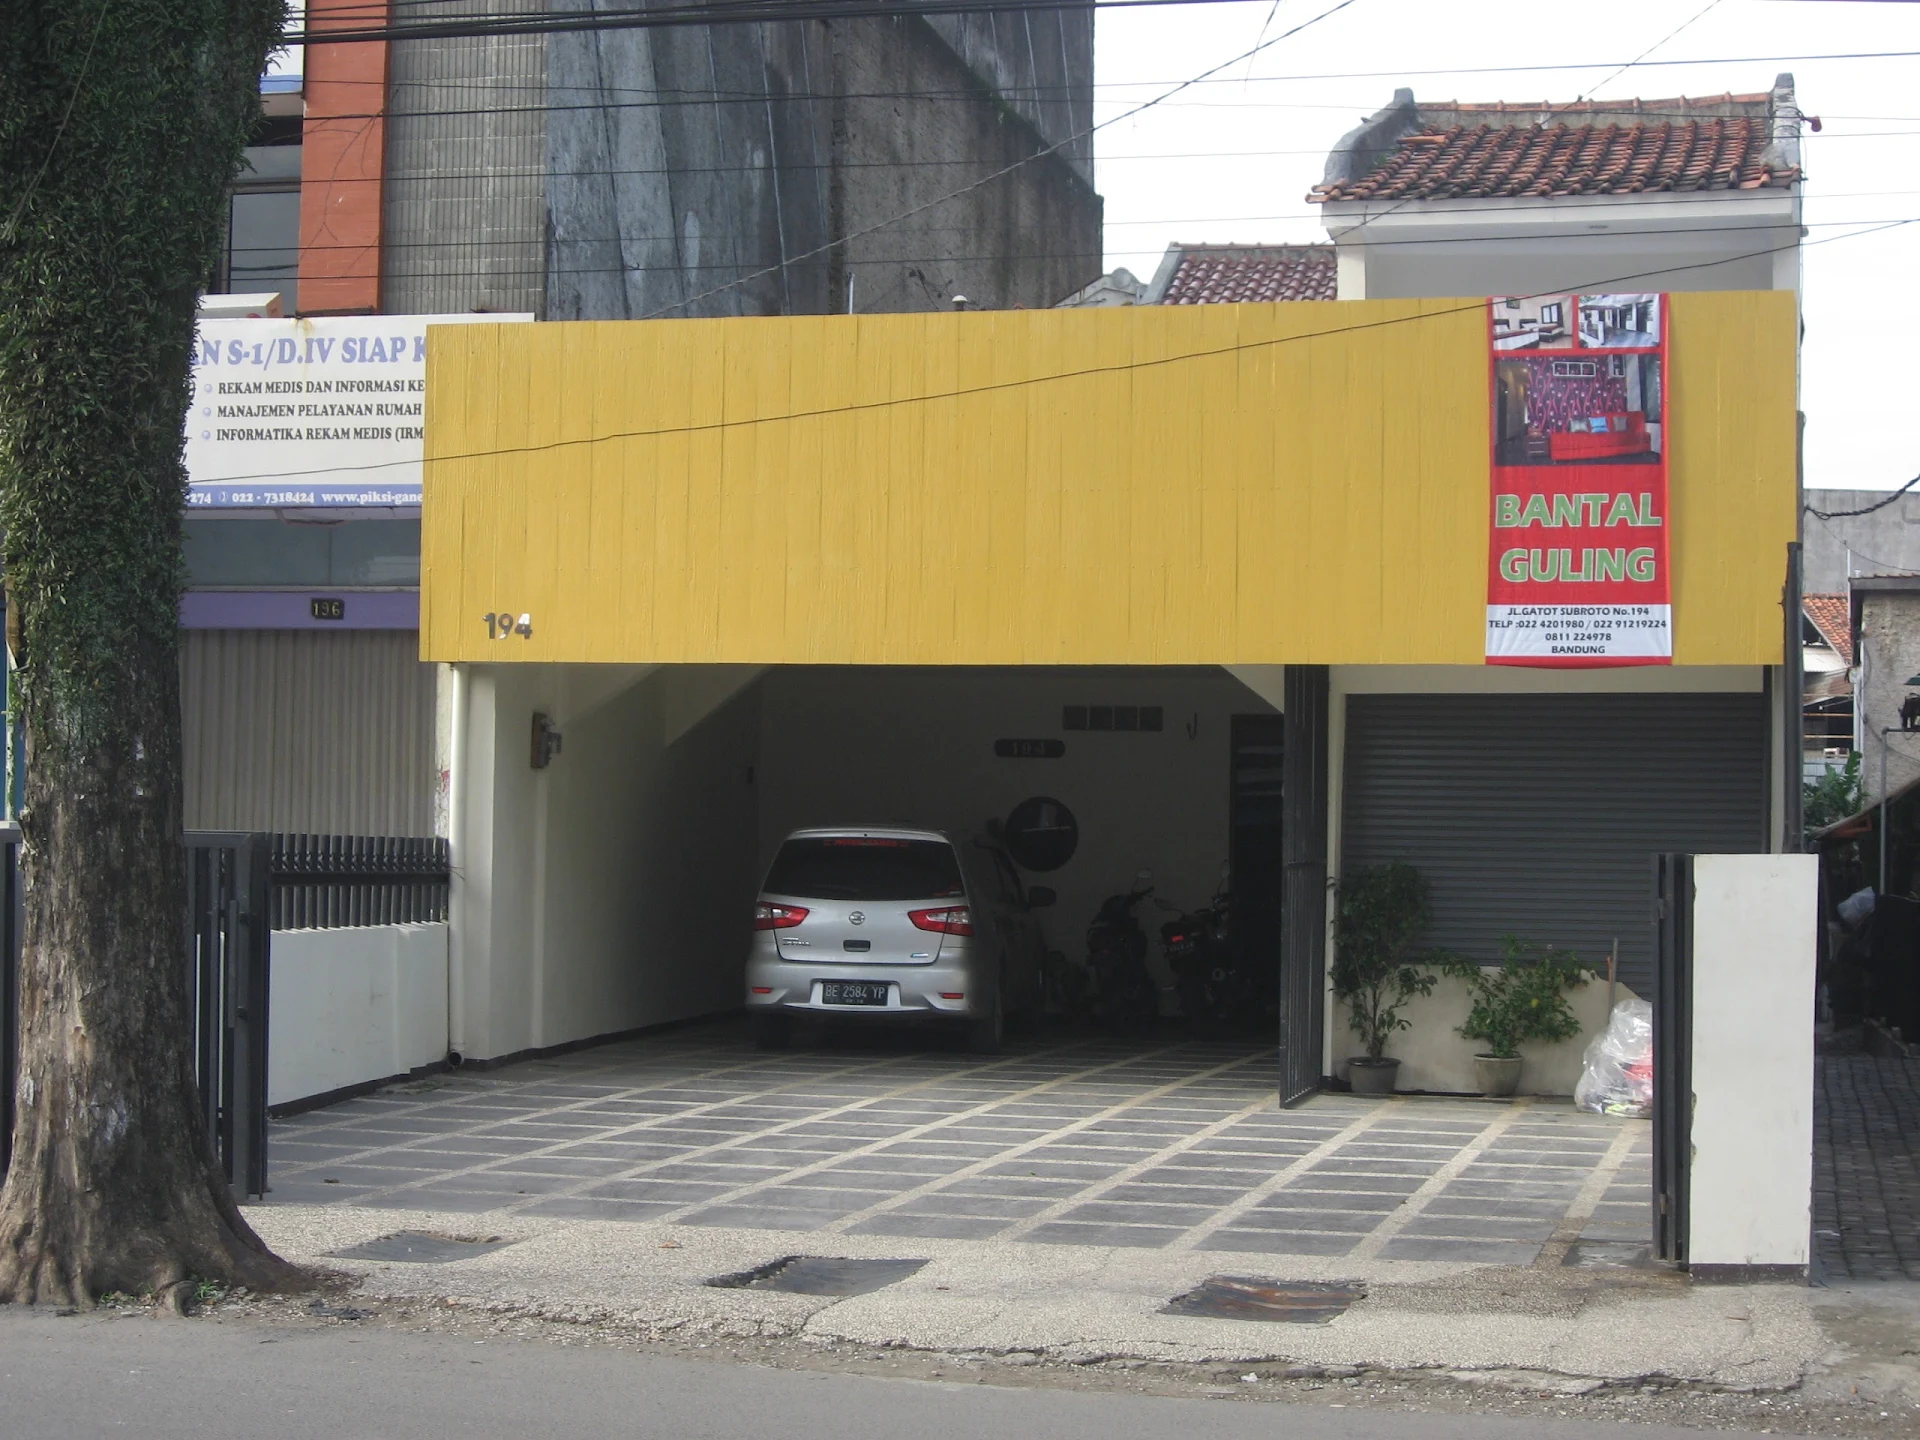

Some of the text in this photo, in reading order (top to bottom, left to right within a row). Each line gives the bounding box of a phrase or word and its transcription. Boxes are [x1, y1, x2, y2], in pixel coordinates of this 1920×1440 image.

[228, 337, 335, 371] S-1/D.IV
[341, 336, 407, 363] SIAP
[218, 382, 262, 394] REKAM
[265, 381, 303, 393] MEDIS
[306, 380, 332, 393] DAN
[335, 380, 405, 392] INFORMASI
[217, 403, 422, 417] MANAJEMEN PELAYANAN RUMAH
[216, 428, 303, 441] INFORMATIKA
[306, 428, 350, 440] REKAM
[353, 427, 392, 439] MEDIS
[231, 492, 254, 503] 022
[263, 491, 315, 504] 7318424
[1495, 492, 1662, 528] BANTAL
[1499, 547, 1656, 583] GULING
[314, 601, 341, 616] 196
[1507, 607, 1558, 616] JL.GATOT
[1560, 607, 1610, 616] SUBROTO
[482, 612, 533, 640] 194
[1488, 620, 1513, 628] TELP
[1539, 620, 1585, 629] 4201980
[1593, 620, 1613, 629] 022
[1615, 620, 1667, 629] 91219224
[1545, 633, 1612, 641] 0811 224978
[1551, 645, 1606, 654] BANDUNG
[825, 984, 886, 999] BE 2584 YP
